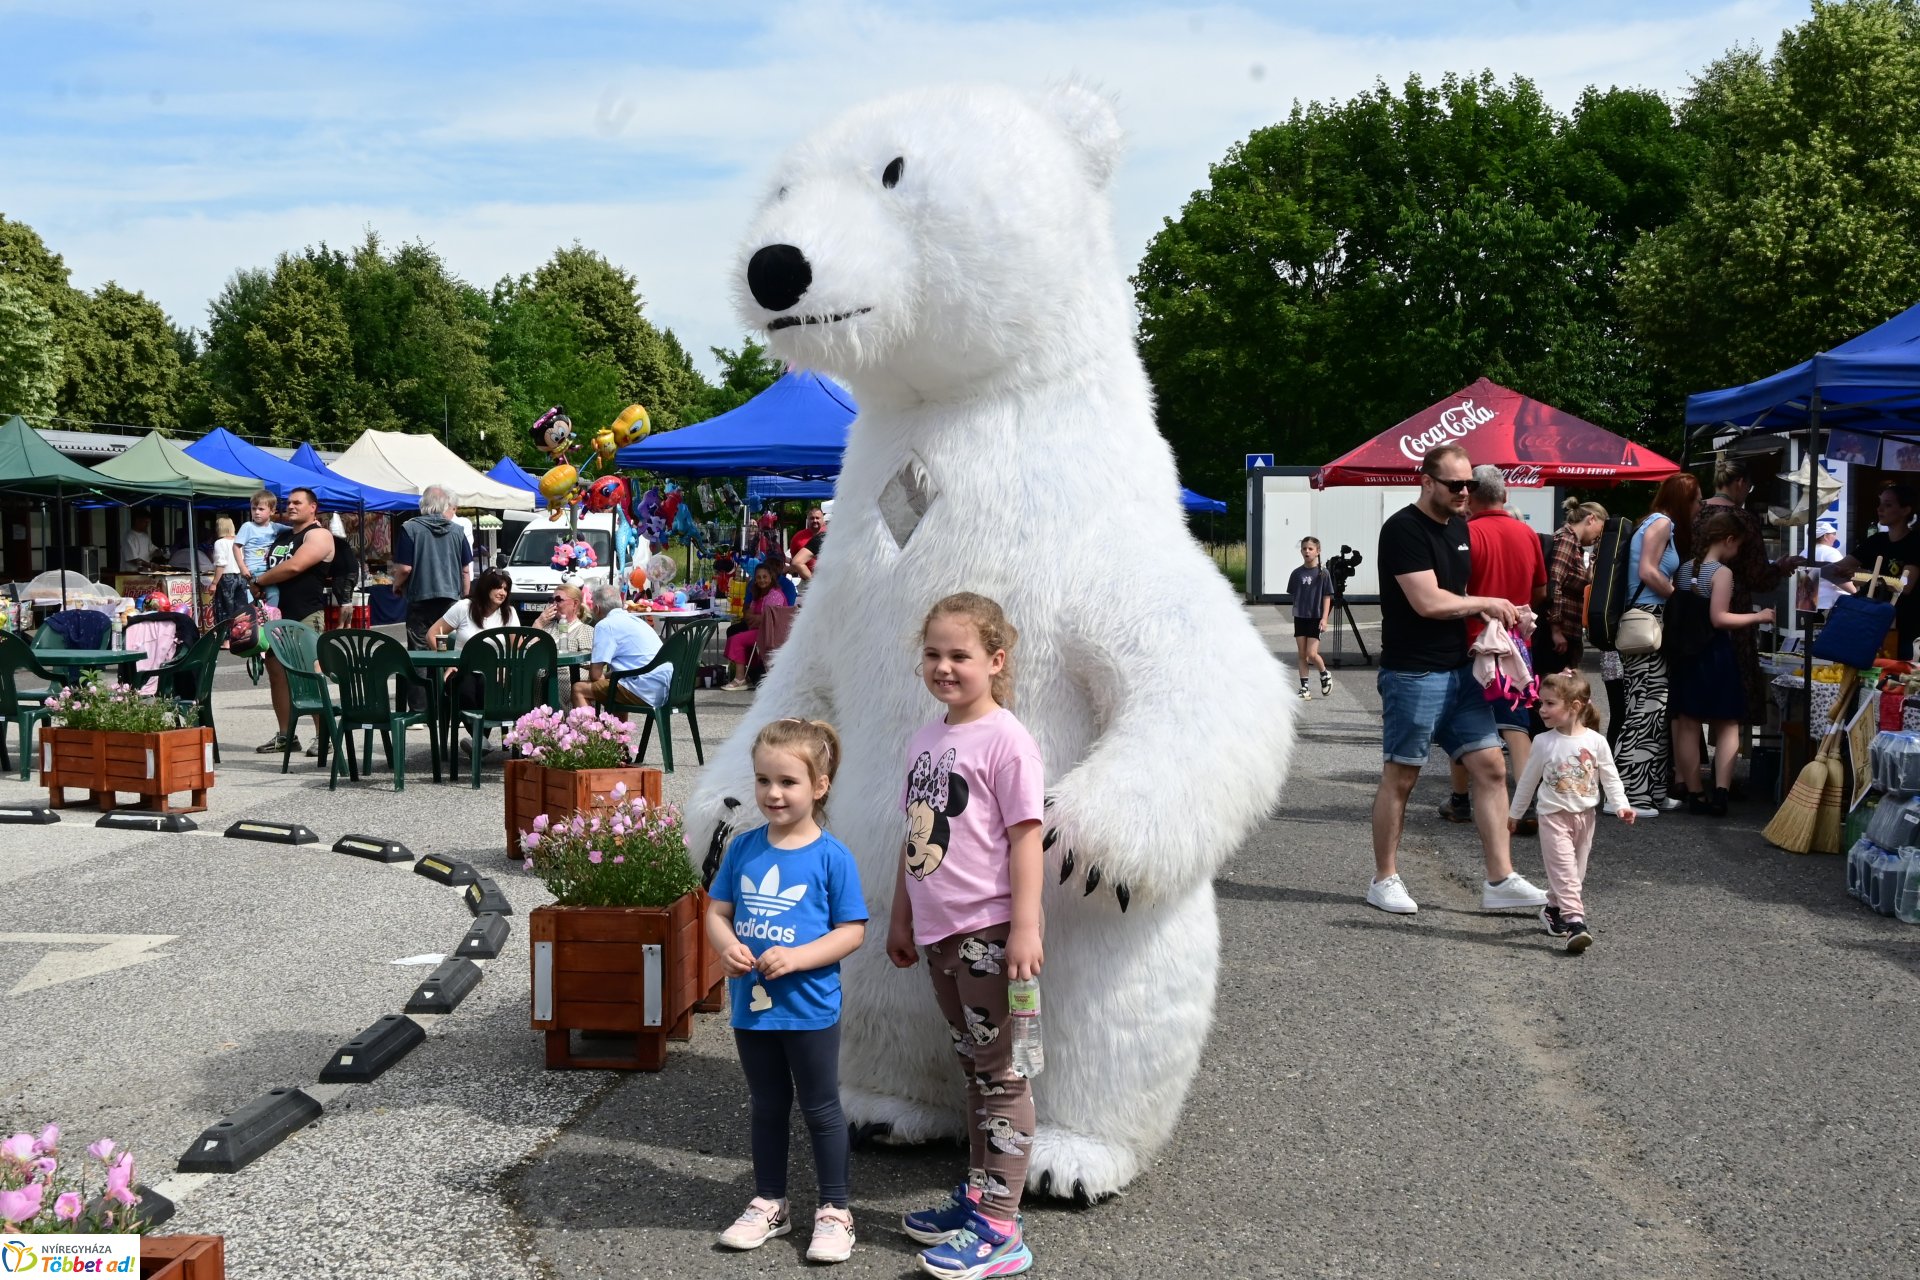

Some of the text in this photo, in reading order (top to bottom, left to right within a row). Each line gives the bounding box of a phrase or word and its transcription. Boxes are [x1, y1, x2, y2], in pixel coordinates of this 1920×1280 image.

[1557, 466, 1616, 476] SOLD HERE
[736, 918, 795, 943] adidas
